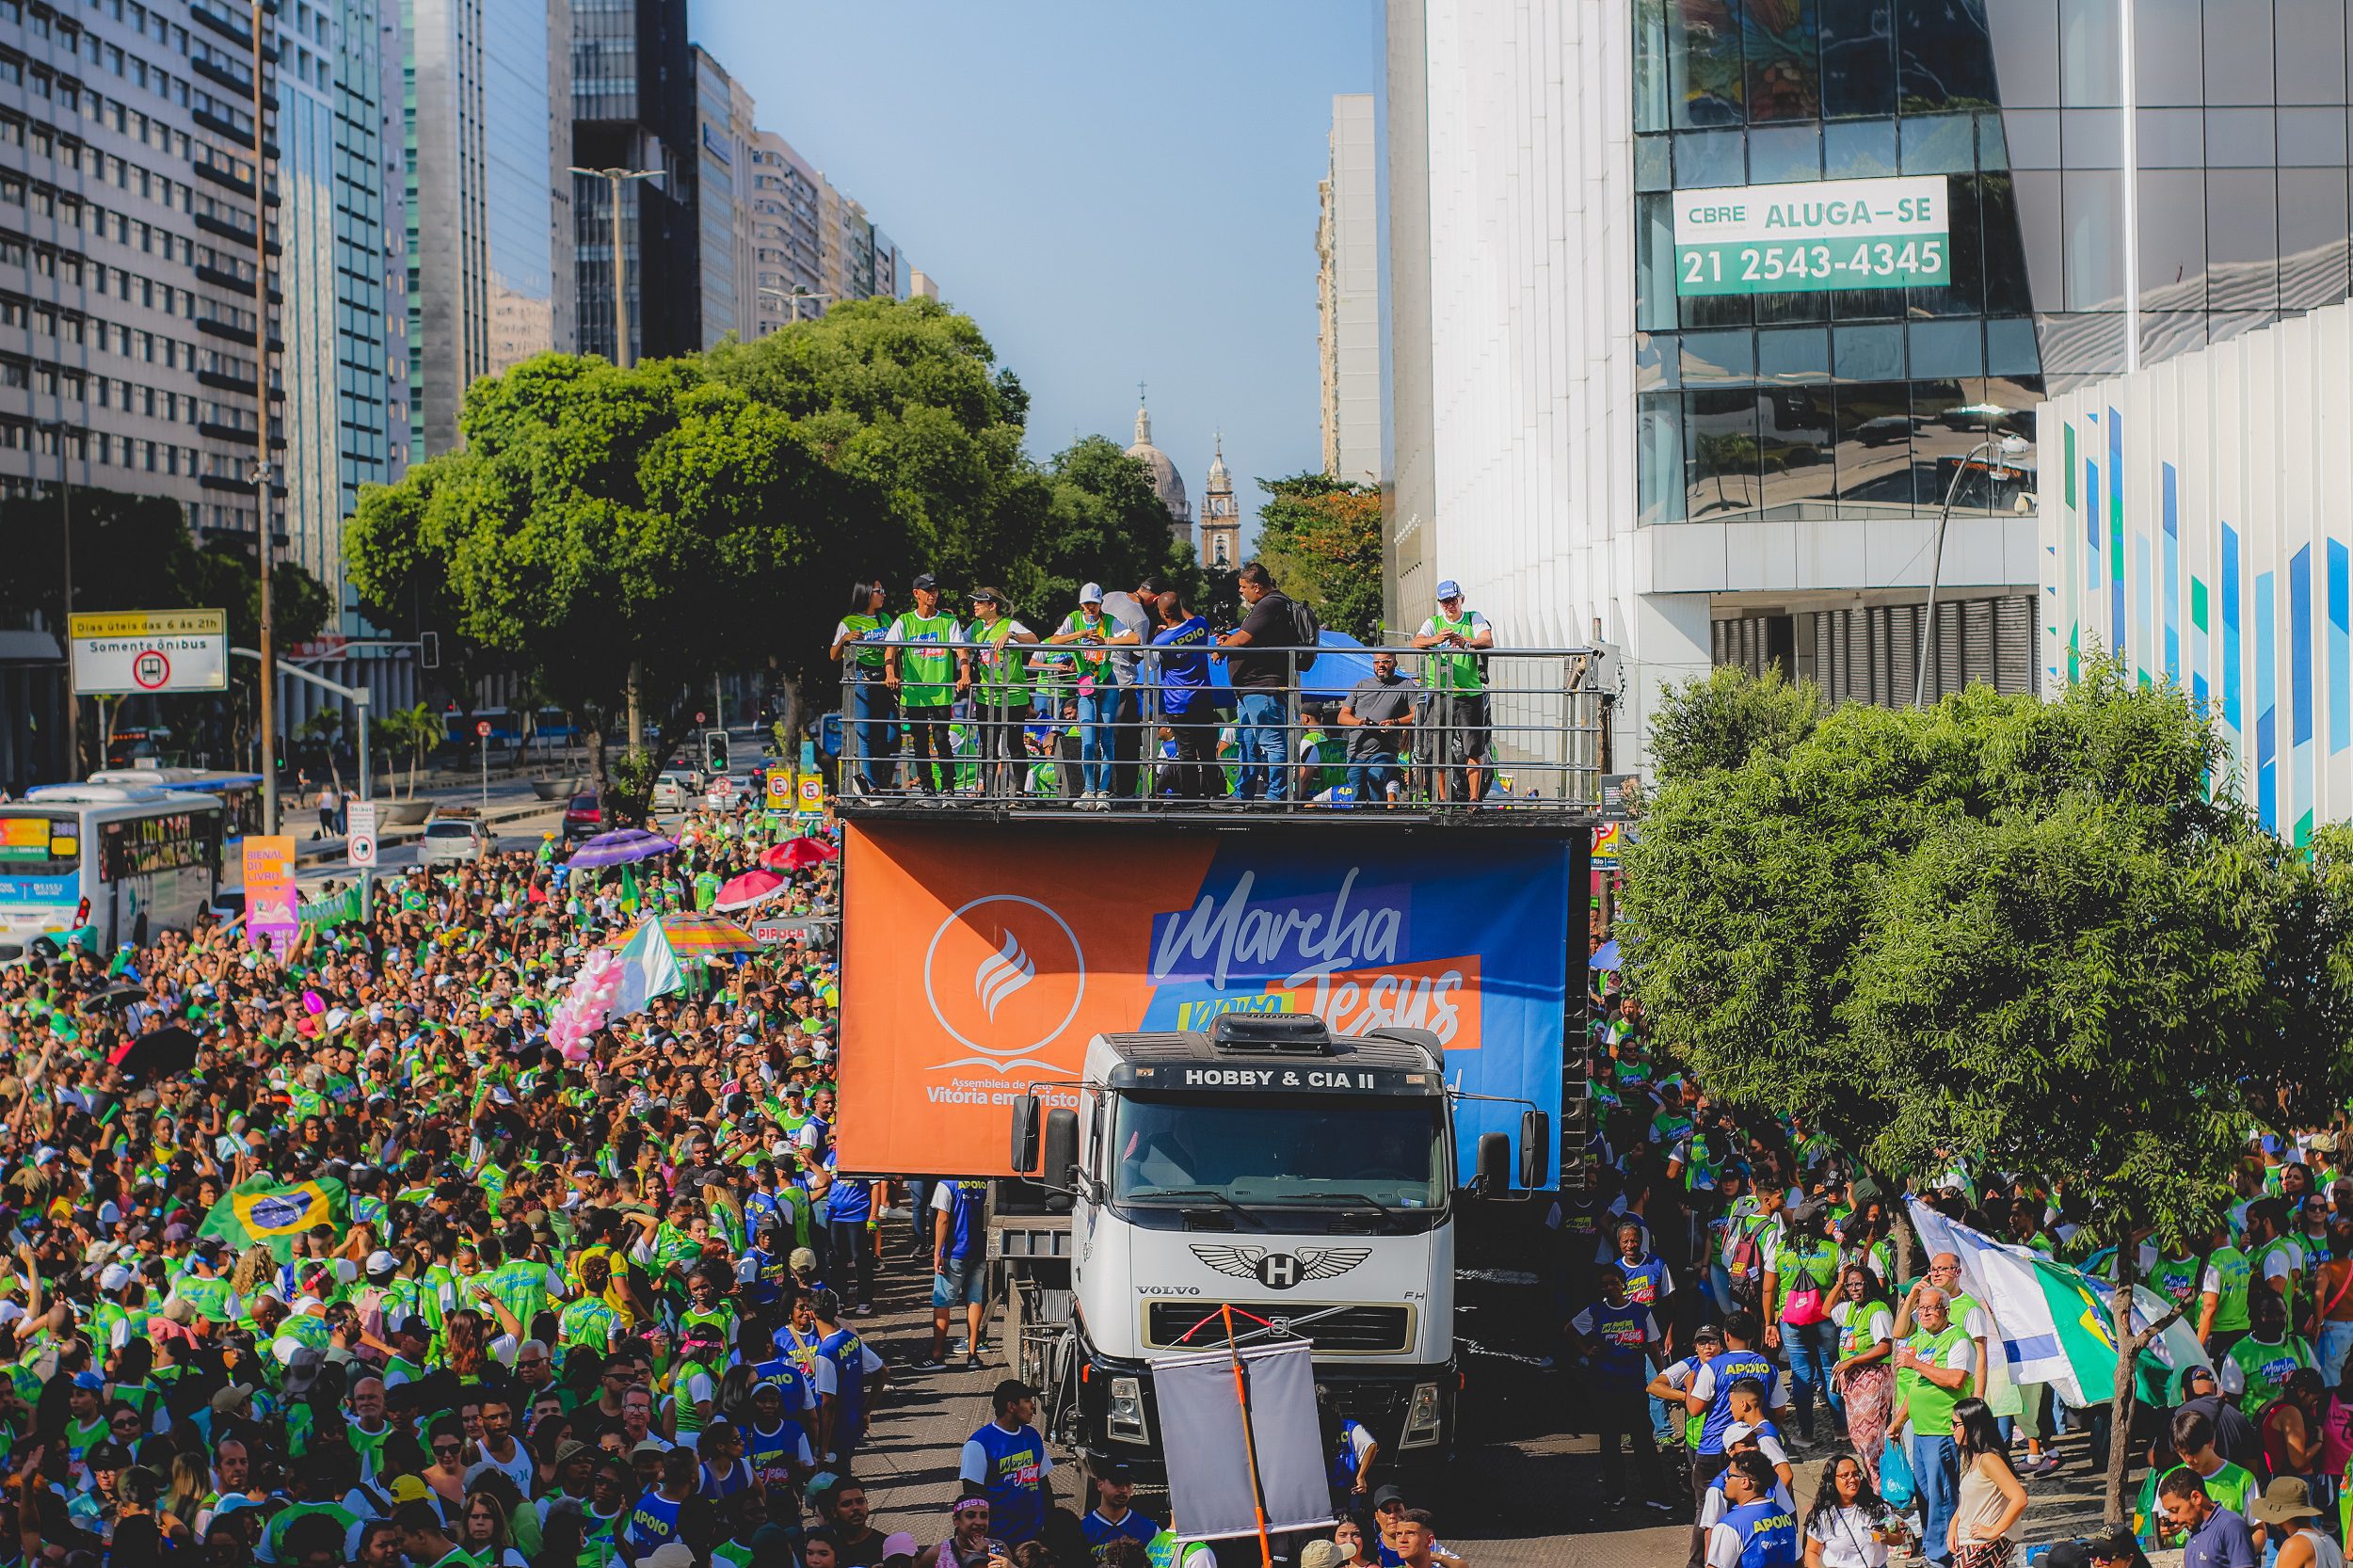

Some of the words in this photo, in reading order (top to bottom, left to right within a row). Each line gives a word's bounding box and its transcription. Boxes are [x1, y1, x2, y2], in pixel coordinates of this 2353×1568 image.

[1689, 204, 1746, 224] CBRE
[1683, 250, 1721, 283] 21
[1740, 240, 1943, 281] 2543-4345
[77, 623, 103, 632] Dias
[107, 622, 137, 632] úteis
[142, 621, 161, 630] das
[198, 619, 216, 628] 21h
[89, 641, 152, 652] Somente
[157, 639, 206, 651] ônibus
[247, 851, 284, 859] BIENAL
[247, 861, 263, 871] DO
[248, 872, 280, 881] LIVRO
[1154, 867, 1401, 990] Marcha
[1283, 957, 1463, 1047] Jesus
[952, 1078, 1010, 1090] Assembleia
[1013, 1080, 1025, 1089] de
[1186, 1069, 1273, 1085] HOBBY
[1282, 1071, 1301, 1086] &
[1308, 1072, 1351, 1088] CIA
[1358, 1074, 1374, 1089] II
[926, 1086, 987, 1105] Vitória
[958, 1181, 987, 1190] APOIO
[1135, 1287, 1200, 1295] VOLVO
[1404, 1291, 1425, 1301] FH
[839, 1337, 859, 1360] APOIO
[1725, 1363, 1770, 1375] APOIO
[1000, 1452, 1032, 1473] Marcha
[633, 1510, 668, 1536] APOIO
[1753, 1513, 1792, 1534] APOIO
